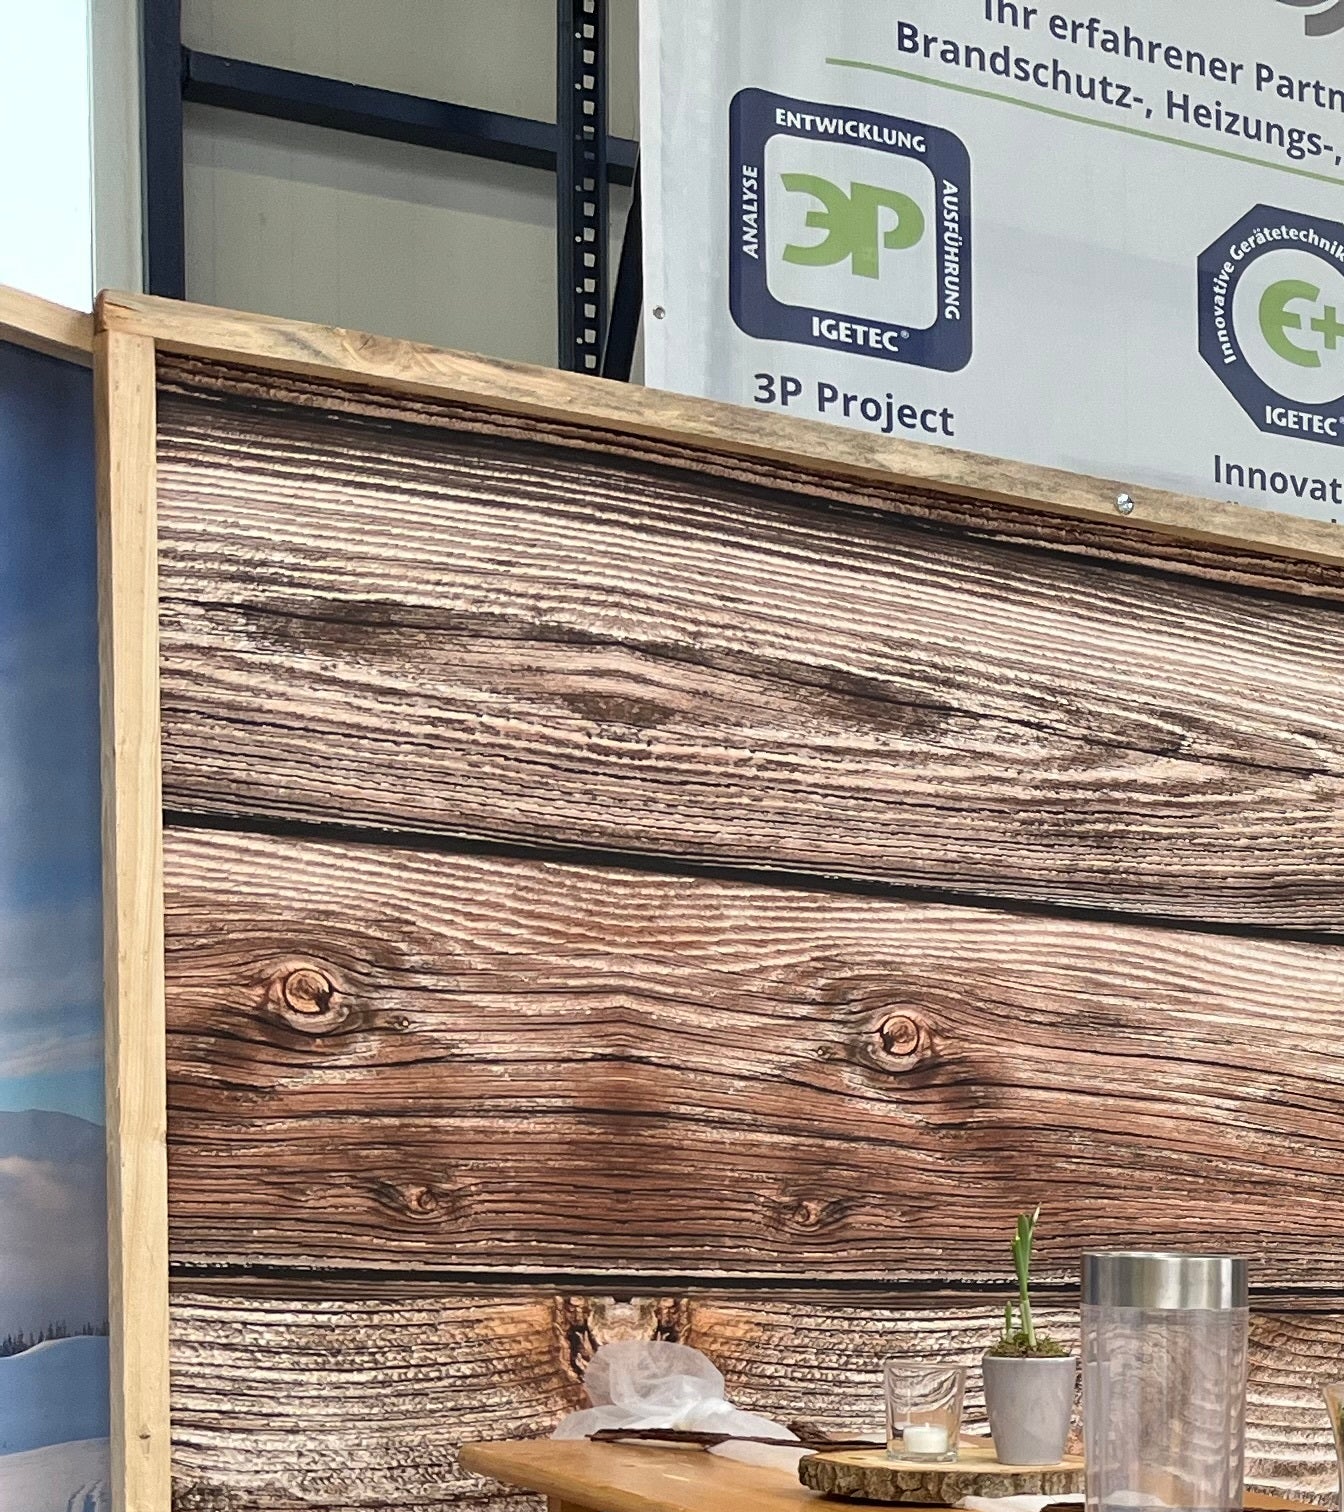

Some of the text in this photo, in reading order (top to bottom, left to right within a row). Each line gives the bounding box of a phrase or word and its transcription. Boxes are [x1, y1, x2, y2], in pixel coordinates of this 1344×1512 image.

[985, 0, 1037, 30] Ihr
[1050, 14, 1243, 84] erfahrener
[775, 108, 926, 153] ENTWICKLUNG
[897, 20, 1153, 118] Brandschutz-,
[1167, 89, 1341, 165] Heizungs-,
[742, 165, 759, 259] ANALYSE
[942, 179, 965, 321] AUSFÜHRUNG
[1213, 260, 1236, 364] Innovative
[754, 373, 954, 437] 3P Project
